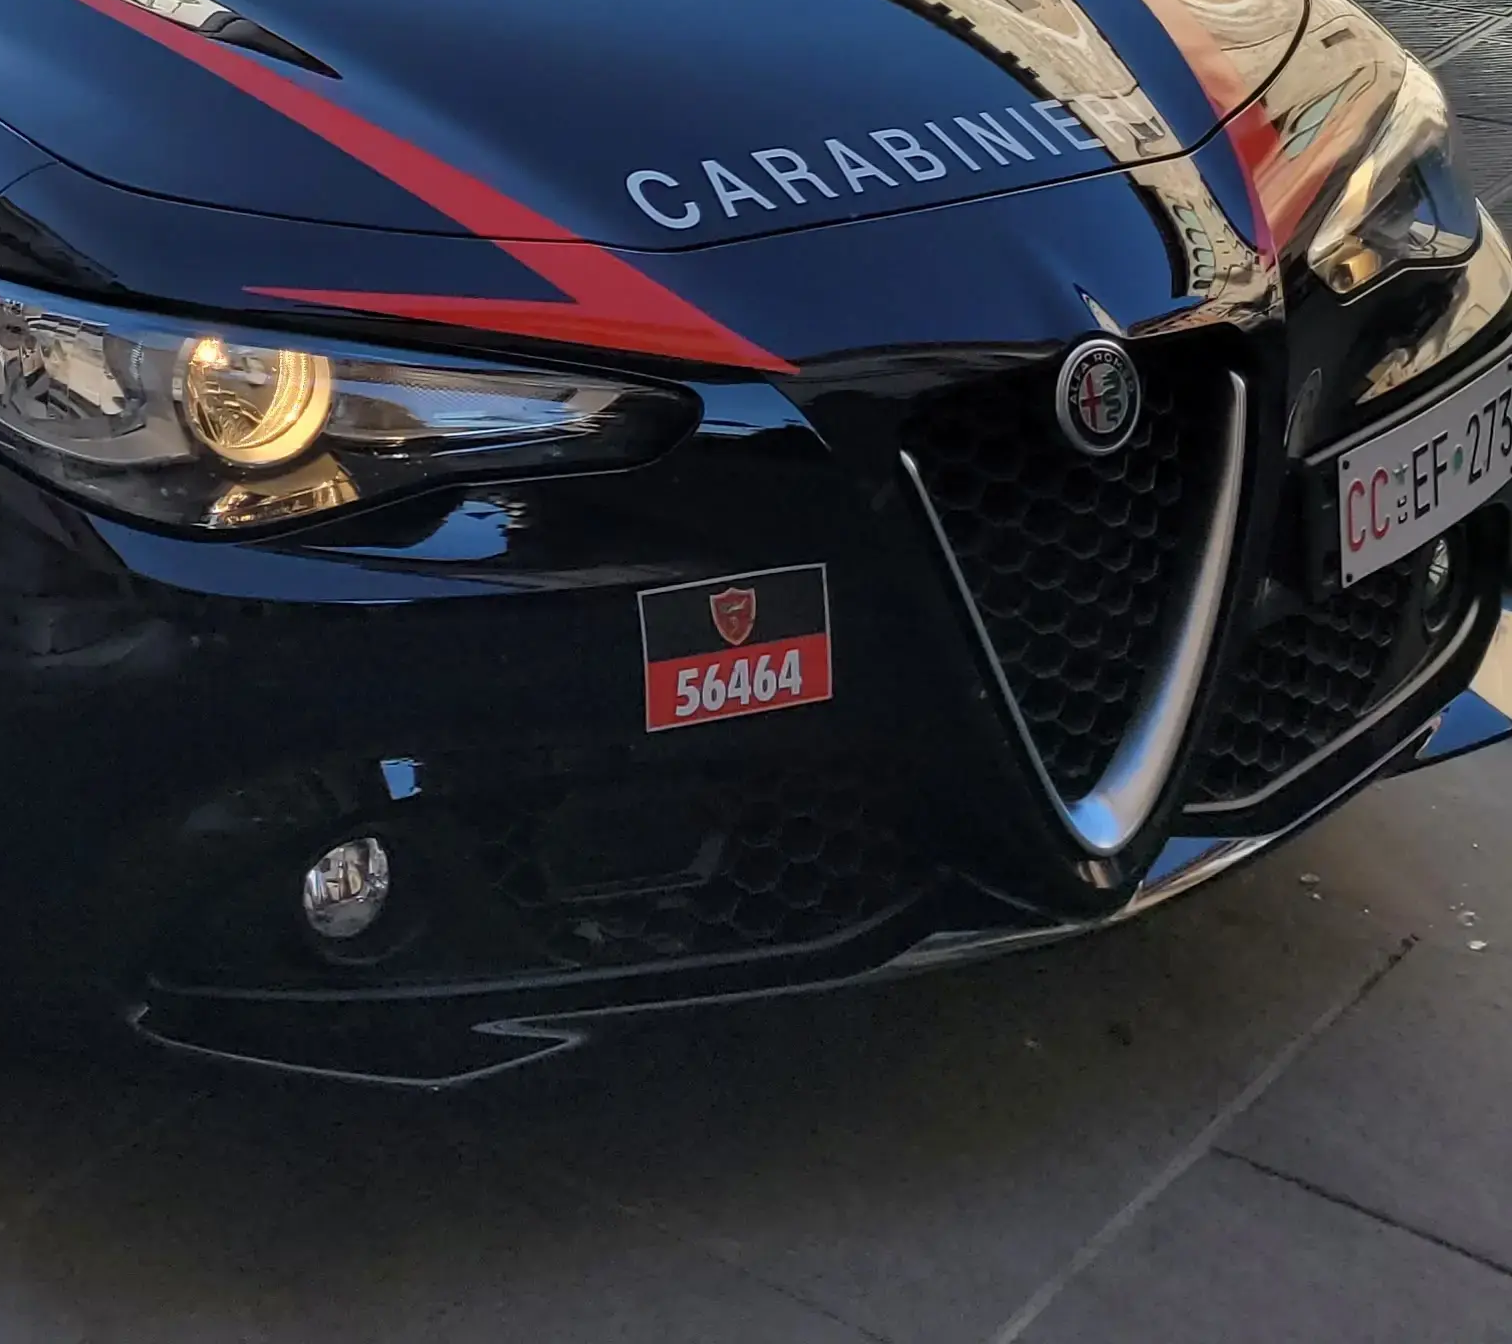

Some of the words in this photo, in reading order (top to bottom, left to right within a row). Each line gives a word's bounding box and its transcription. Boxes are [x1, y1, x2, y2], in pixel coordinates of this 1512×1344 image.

[625, 89, 1166, 231] CARABINIERI
[1347, 467, 1390, 552] CC
[1412, 430, 1448, 520] EF
[675, 649, 803, 718] 56464
